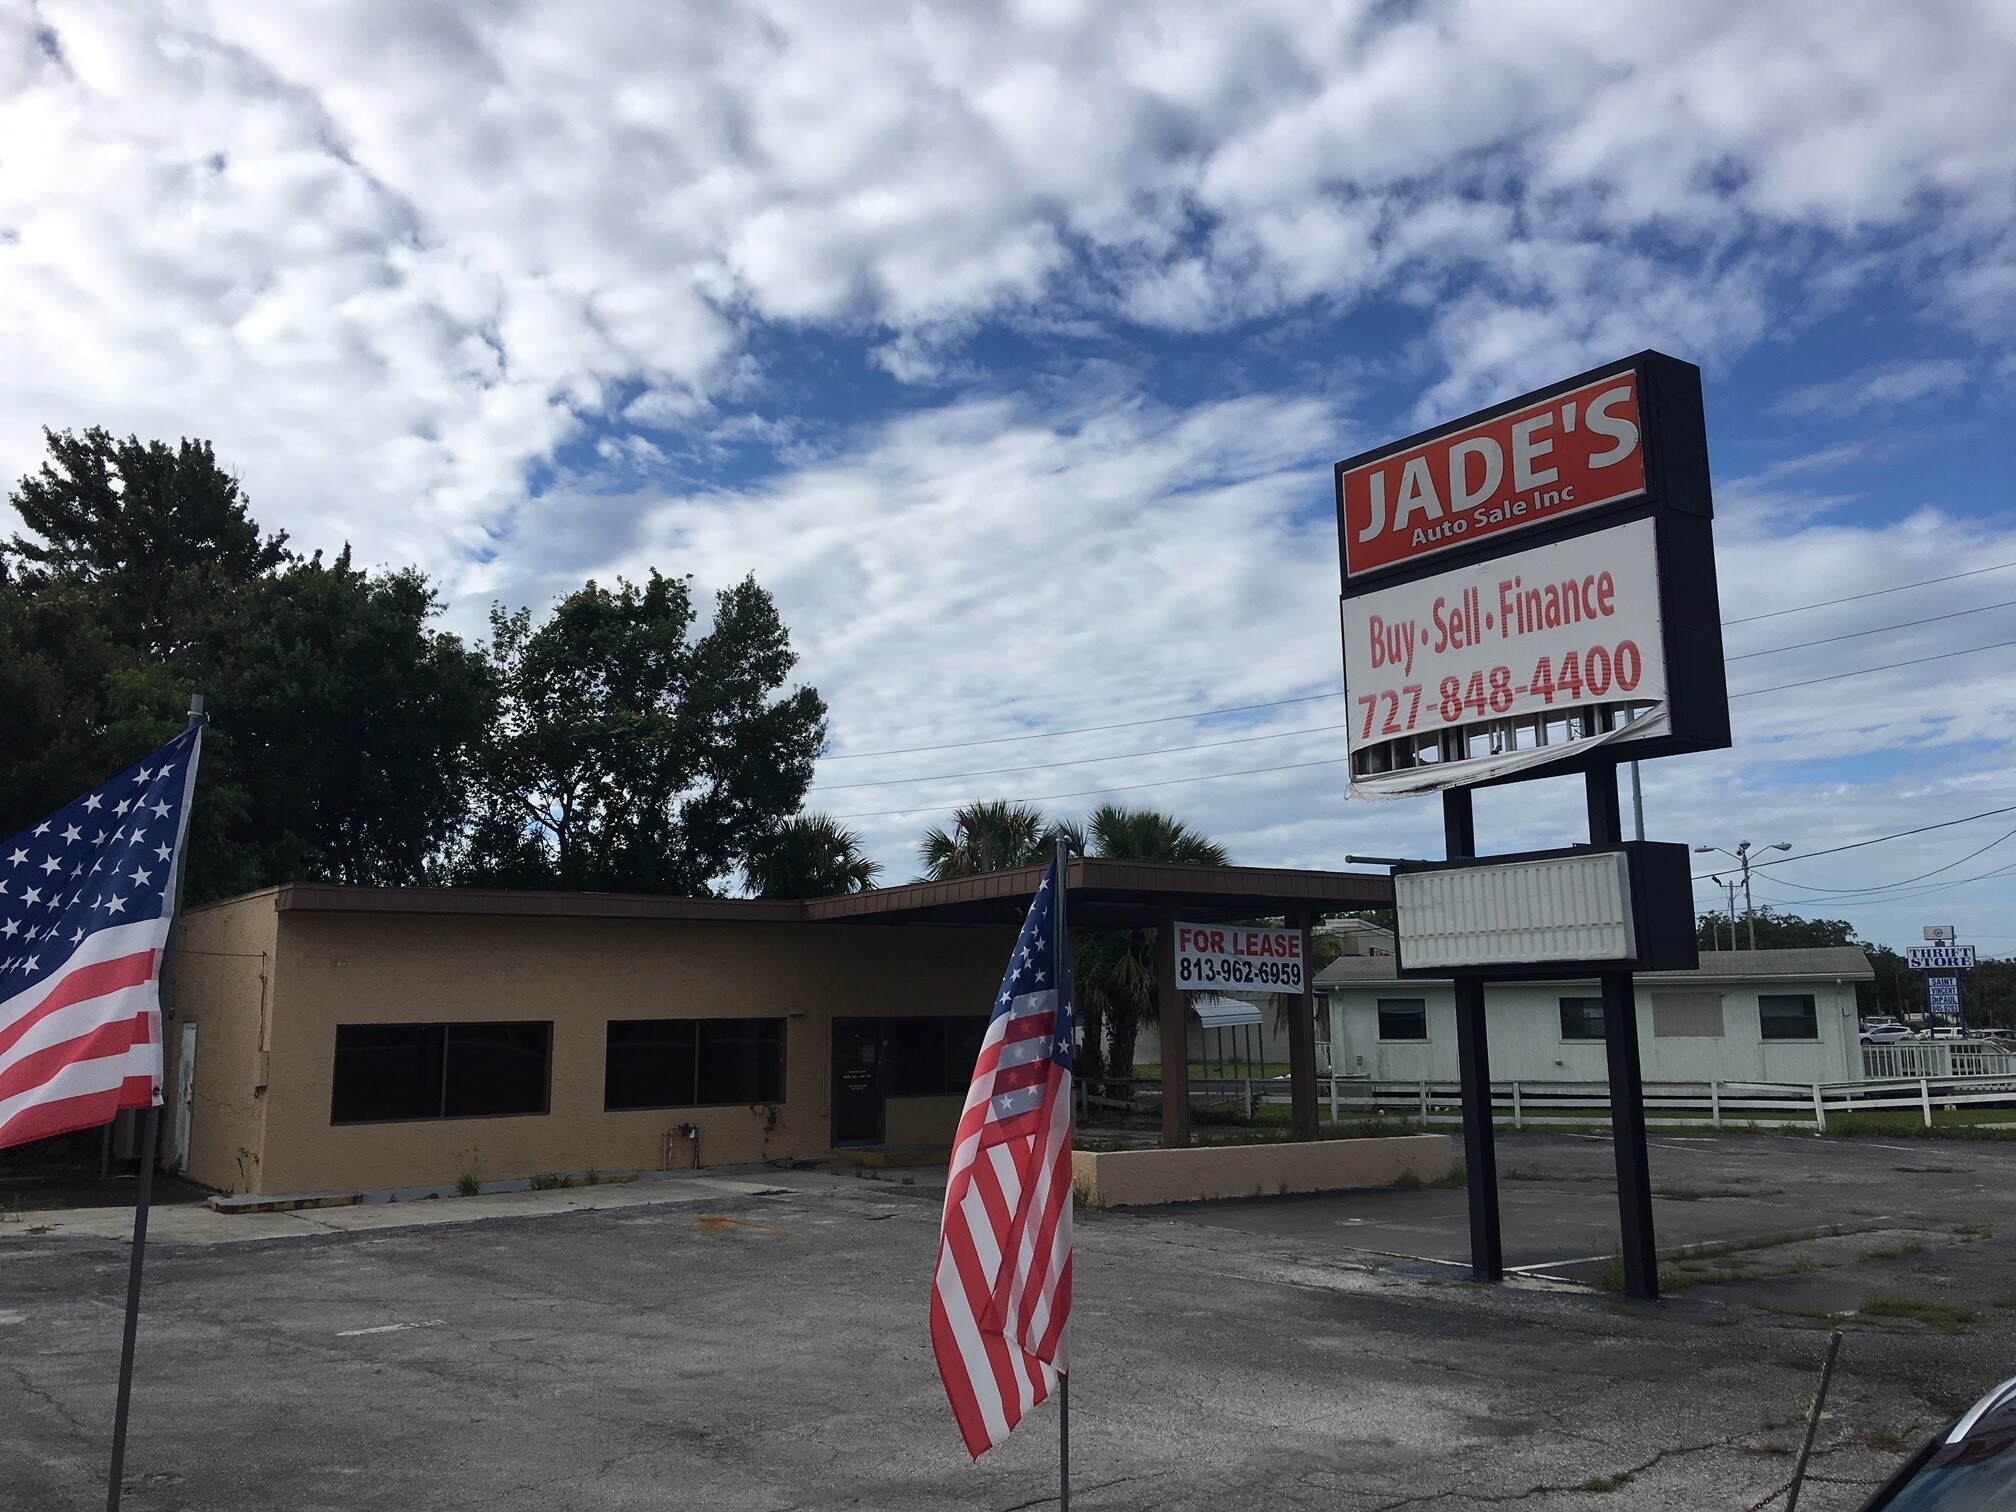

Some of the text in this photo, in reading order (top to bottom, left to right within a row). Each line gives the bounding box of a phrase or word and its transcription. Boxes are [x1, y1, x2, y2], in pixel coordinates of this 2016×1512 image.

[1358, 386, 1640, 543] JADE'S
[1411, 485, 1575, 547] Auto Sale Inc
[1358, 639, 1642, 739] 727-848-4400
[1179, 928, 1300, 958] FOR LEASE
[1909, 947, 1971, 958] THRIFT
[1180, 957, 1301, 986] 813-962-6959
[1910, 957, 1972, 967] STORE
[1930, 987, 1956, 995] VINCENT
[1931, 978, 1954, 986] SAINT
